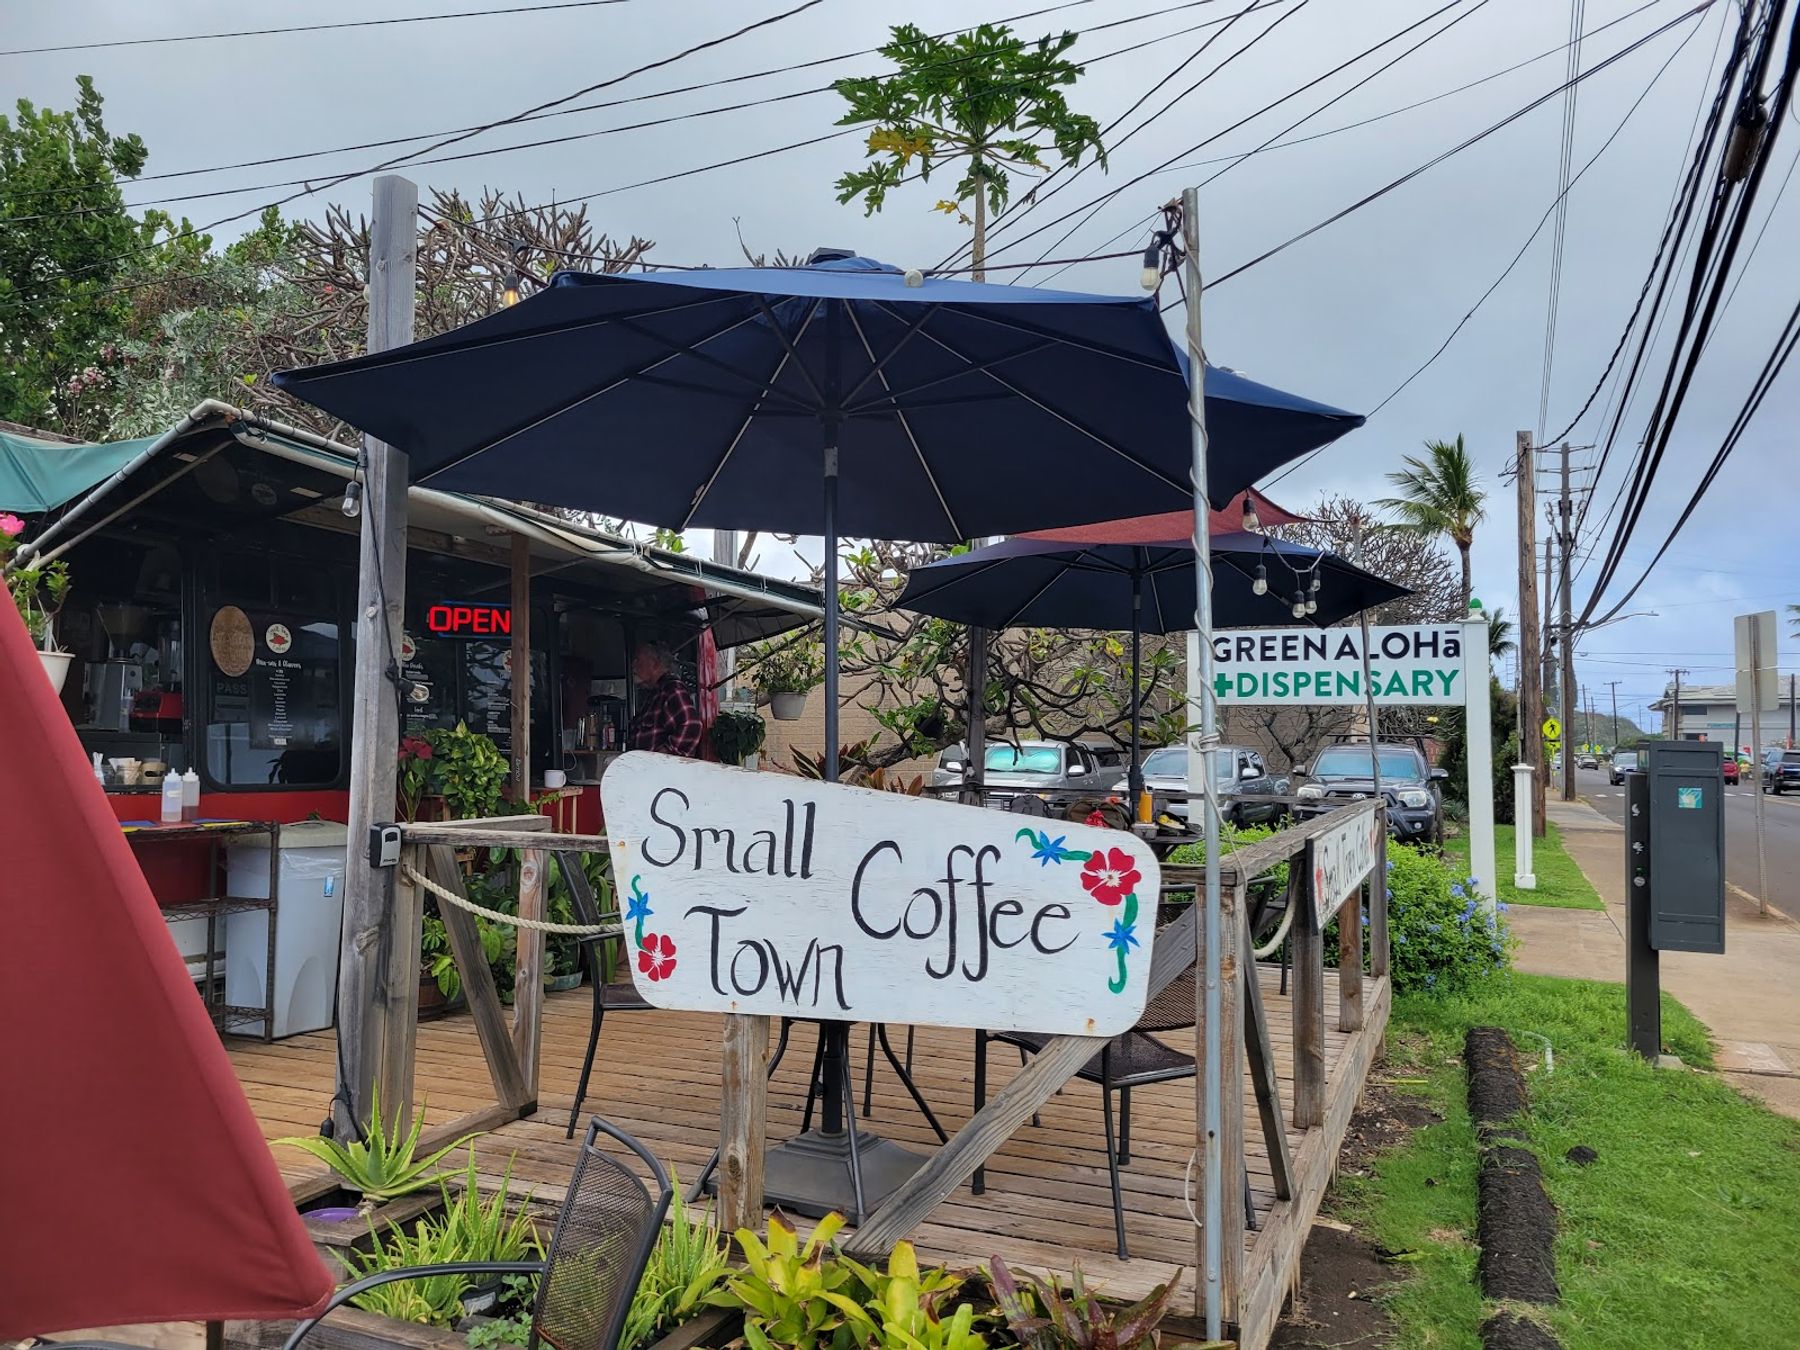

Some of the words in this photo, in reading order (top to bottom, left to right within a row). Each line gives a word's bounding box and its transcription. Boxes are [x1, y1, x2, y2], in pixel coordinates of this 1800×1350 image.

[429, 606, 511, 633] OPEN
[1213, 635, 1327, 662] GREEN
[217, 683, 248, 695] PASS
[1237, 669, 1459, 697] DISPENSARY
[641, 787, 816, 879] Small
[852, 840, 1081, 982] Coffee
[684, 905, 852, 1010] Town
